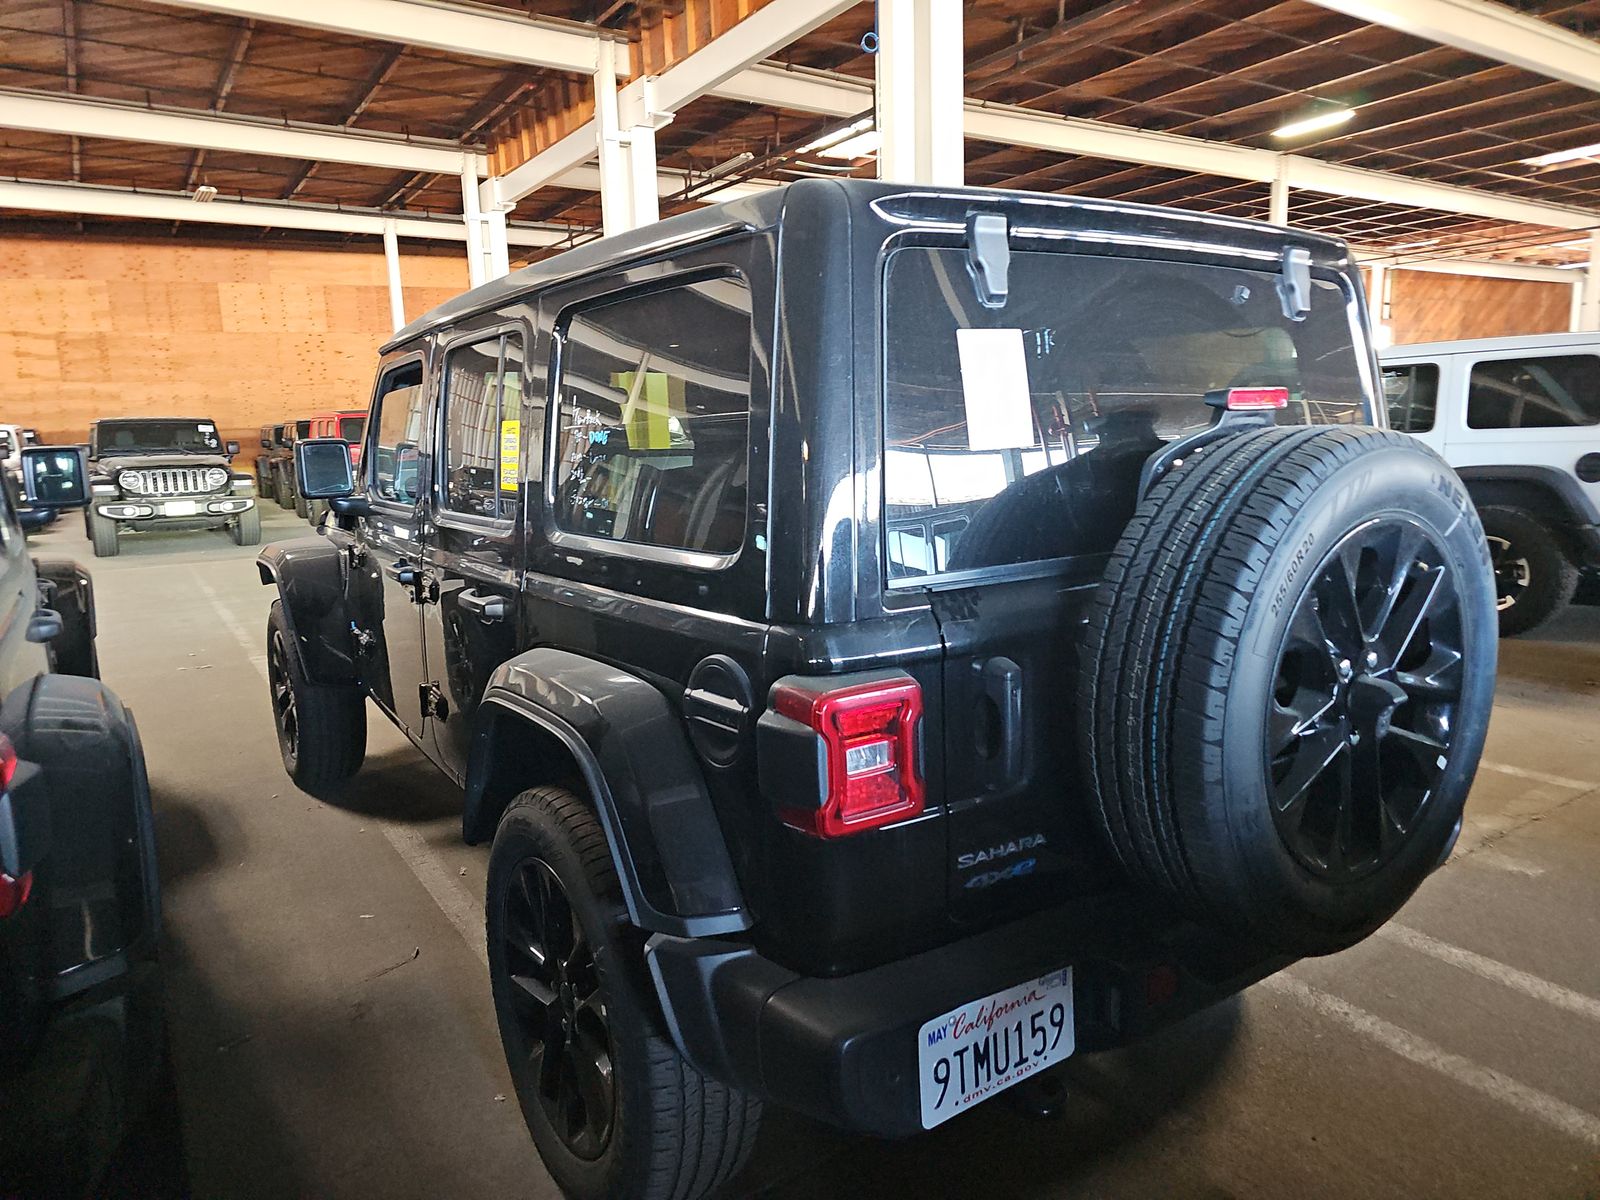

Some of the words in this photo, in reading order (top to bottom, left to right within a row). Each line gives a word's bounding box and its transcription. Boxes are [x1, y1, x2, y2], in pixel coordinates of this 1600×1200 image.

[957, 834, 1046, 869] SAHARA
[927, 1024, 948, 1047] MAY
[953, 988, 1046, 1040] California
[933, 1002, 1065, 1110] 9TMU159
[963, 1060, 1040, 1104] dmv.ca.gov
